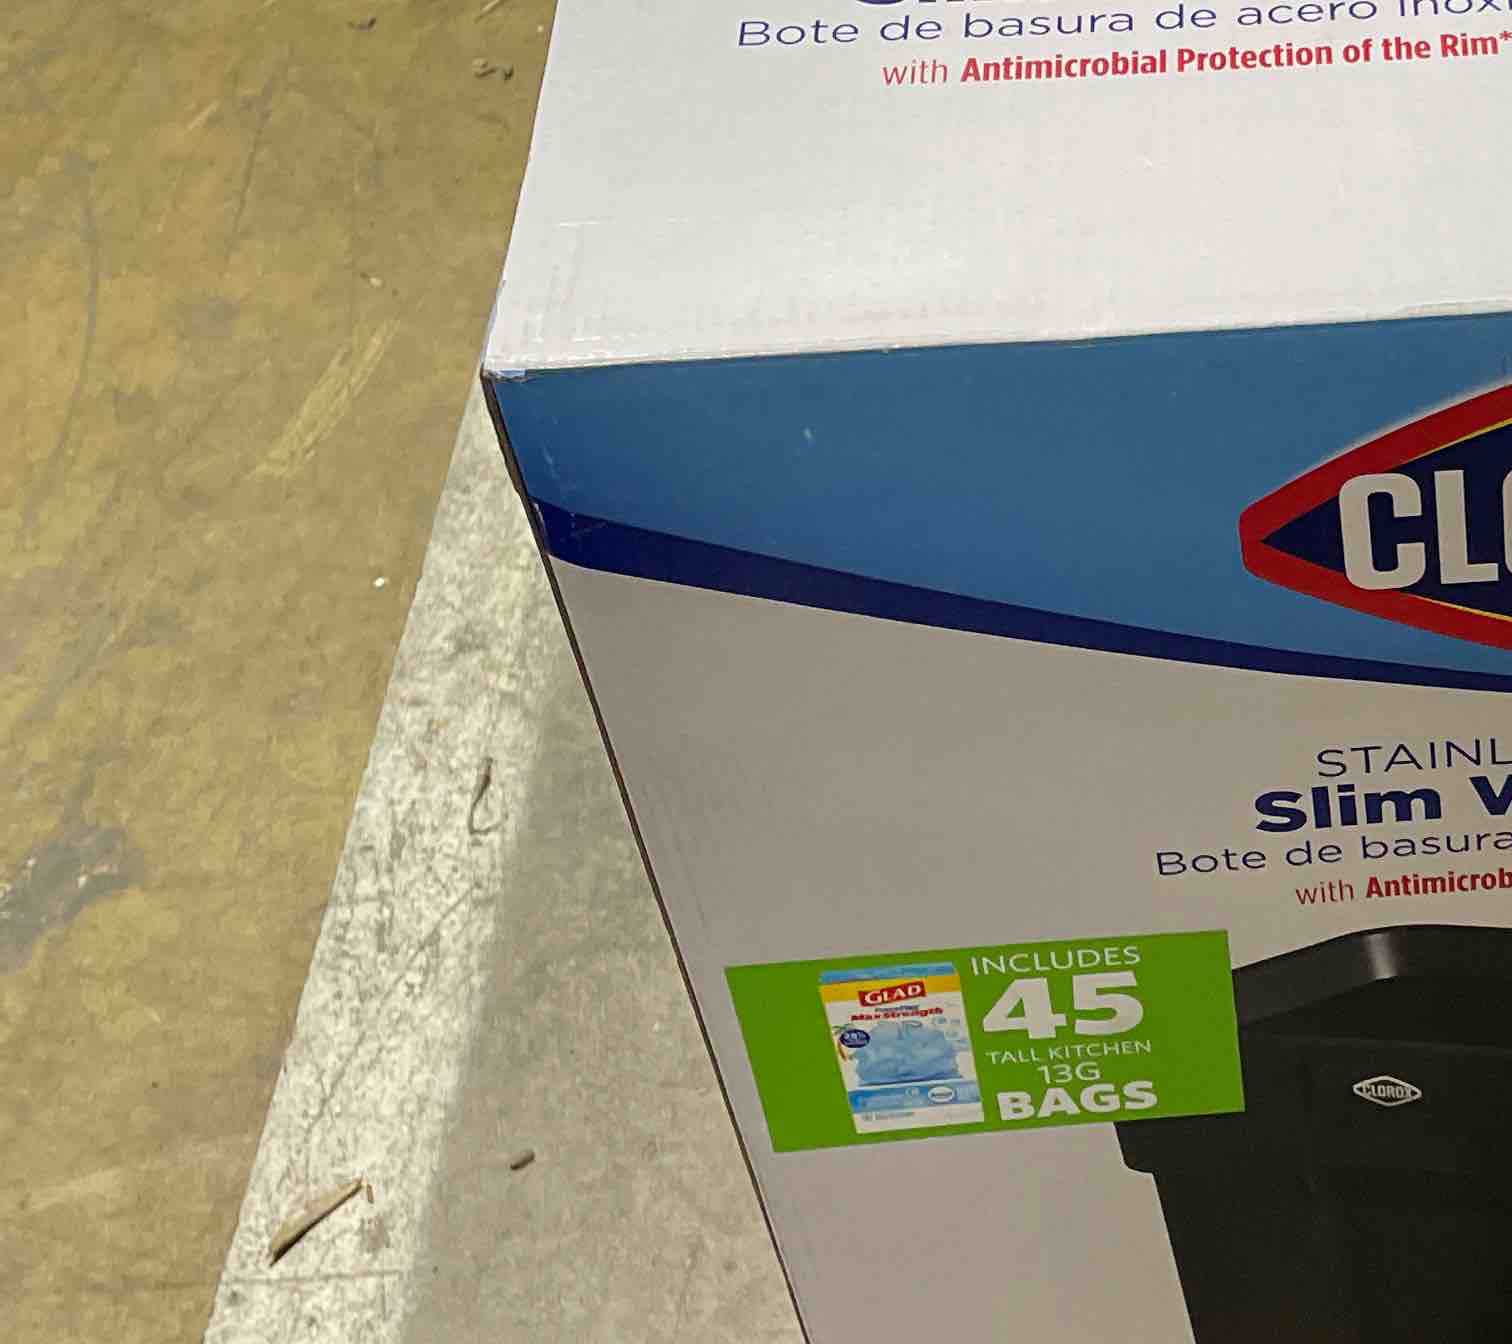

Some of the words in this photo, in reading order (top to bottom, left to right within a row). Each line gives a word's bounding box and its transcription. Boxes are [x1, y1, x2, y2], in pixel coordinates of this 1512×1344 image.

[738, 16, 859, 49] Bote
[879, 12, 942, 43] de
[963, 7, 1134, 39] basura
[1155, 0, 1217, 30] de
[881, 57, 948, 87] with
[960, 46, 1168, 84] Antimicrobial
[1176, 37, 1335, 74] Protection
[1342, 35, 1374, 62] of
[1381, 34, 1434, 61] the
[1254, 781, 1442, 835] Slim
[1156, 845, 1267, 877] Bote
[1285, 839, 1343, 869] de
[1295, 877, 1355, 906] with
[971, 946, 1141, 976] INCLUDES
[864, 985, 922, 1005] GLAD
[982, 971, 1144, 1040] 45
[986, 1047, 1040, 1065] TALL
[1048, 1039, 1152, 1060] KITCHEN
[1037, 1062, 1101, 1084] 13G
[996, 1080, 1158, 1121] BAGS
[1362, 1083, 1412, 1099] CLOROX
